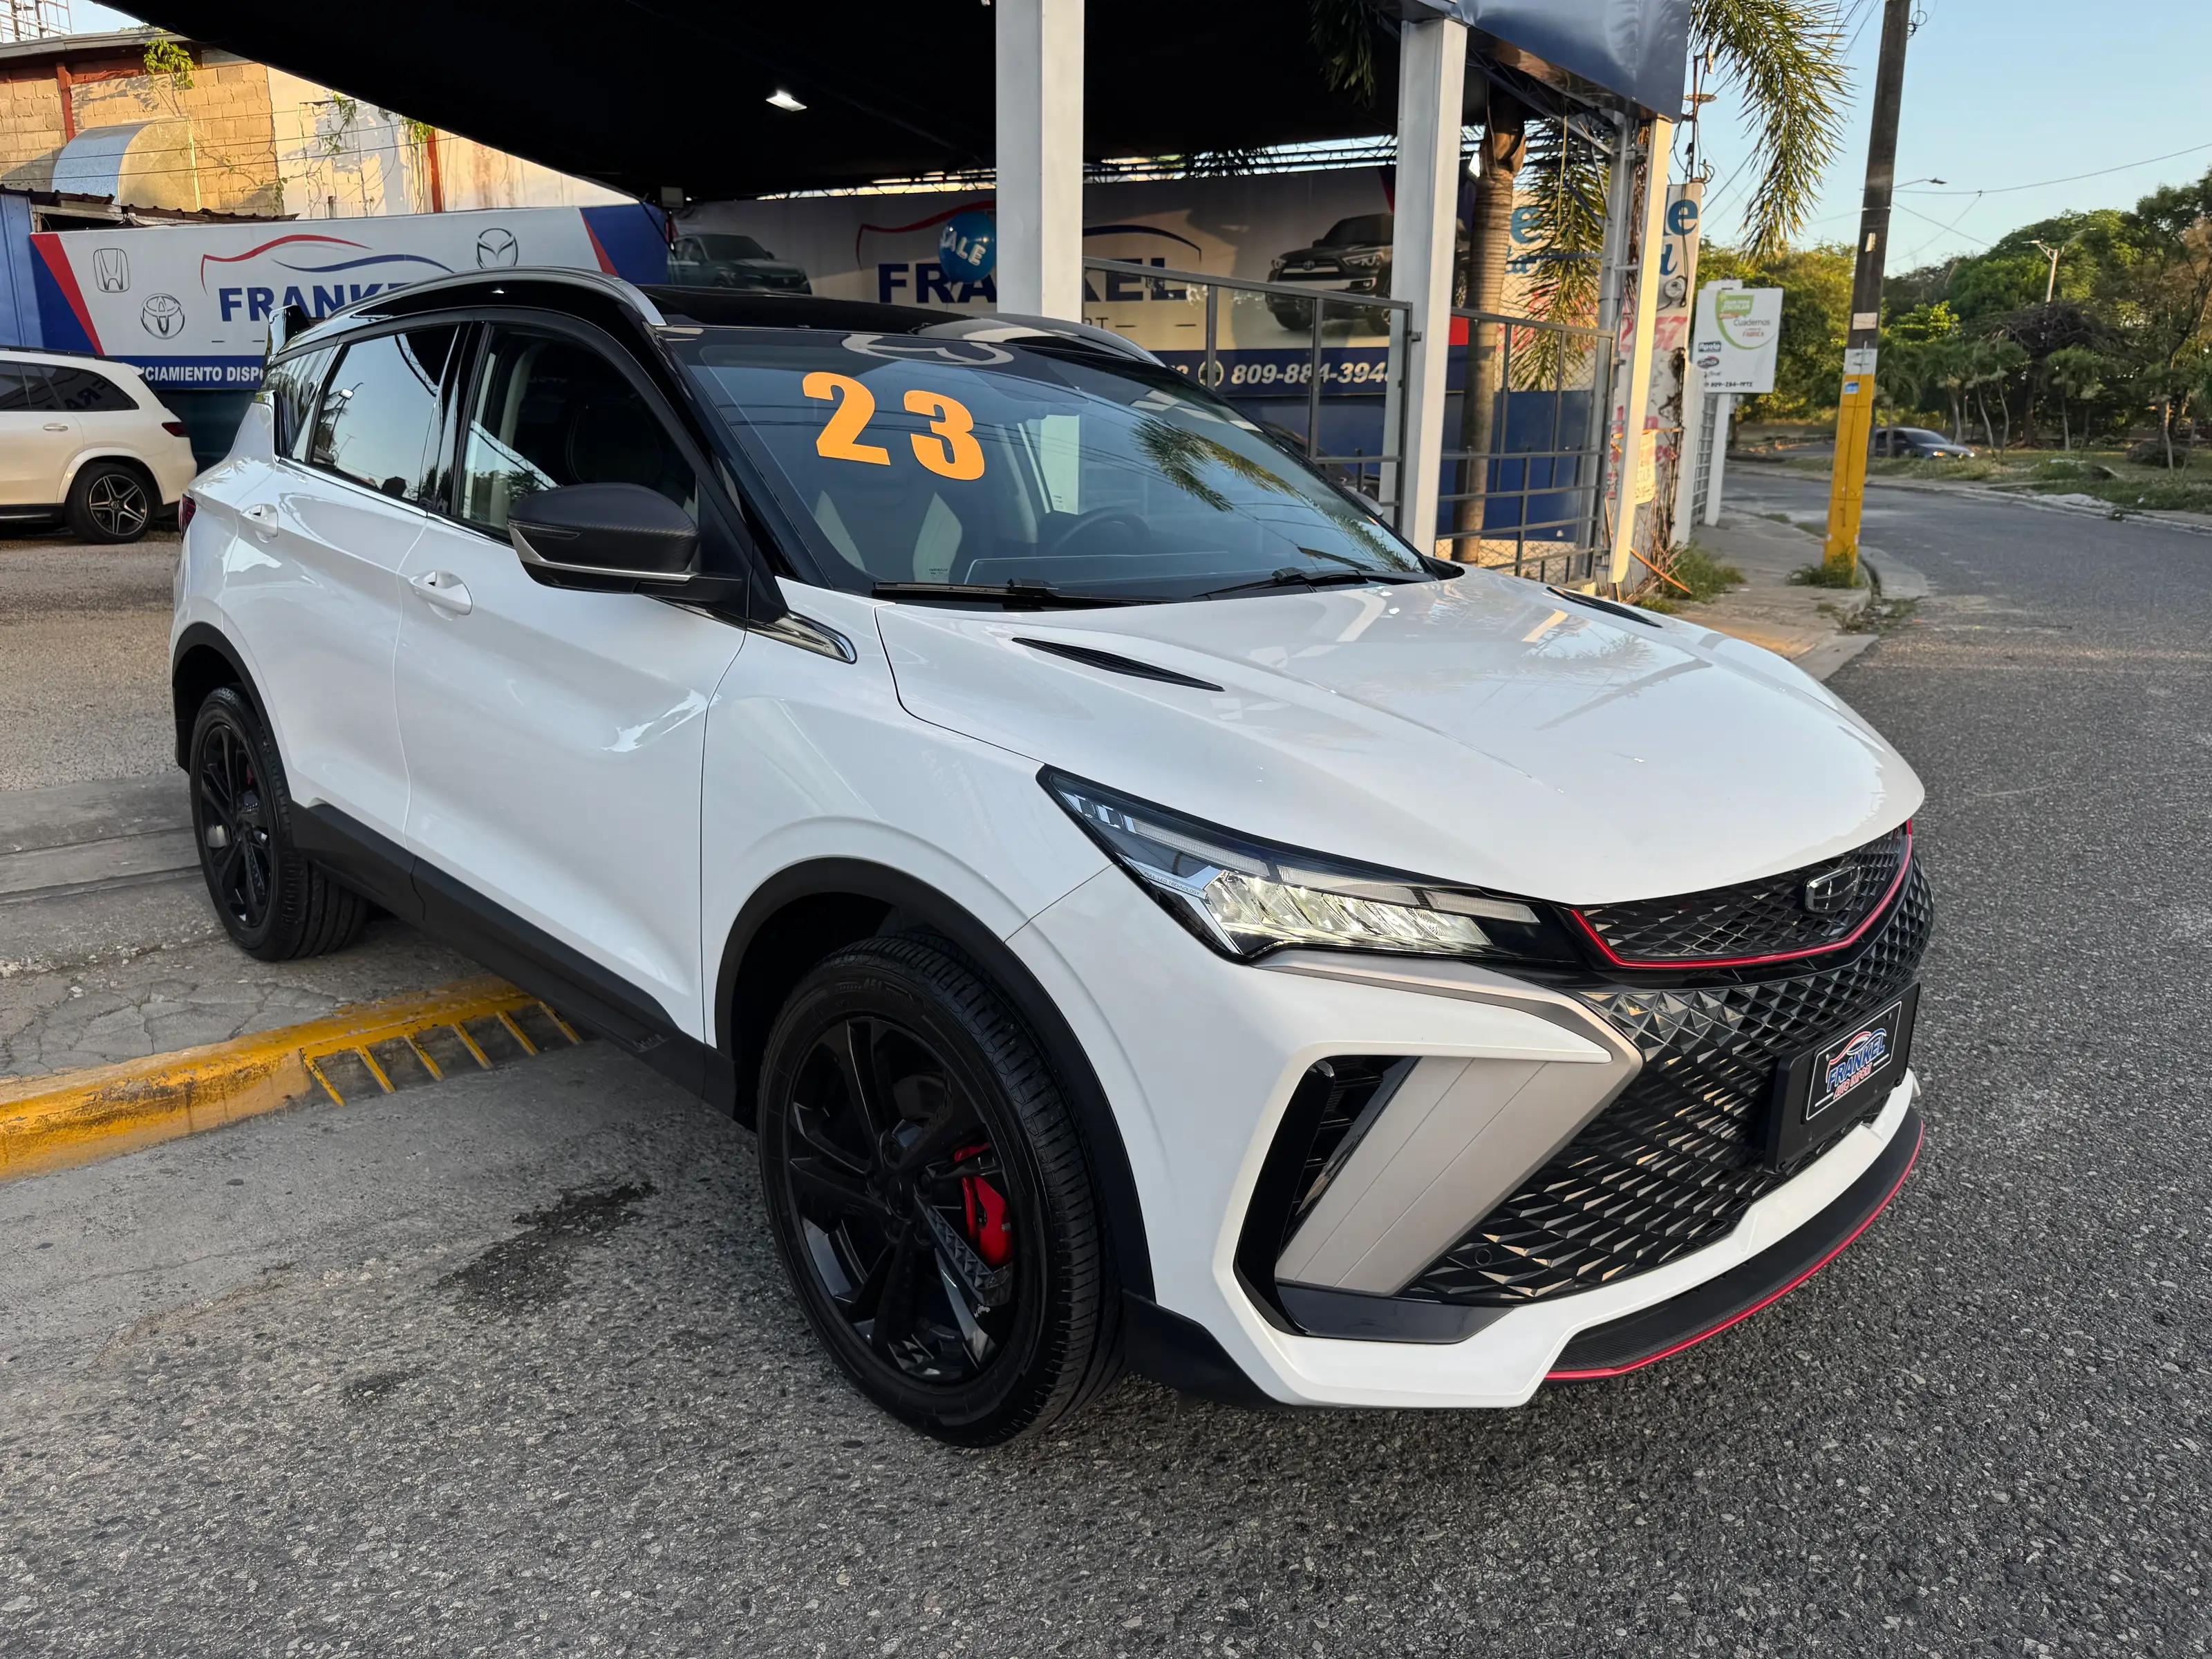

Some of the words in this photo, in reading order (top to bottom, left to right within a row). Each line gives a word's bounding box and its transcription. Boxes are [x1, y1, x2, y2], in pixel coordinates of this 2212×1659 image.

[1231, 362, 1388, 384] 809-884-394
[1168, 881, 1200, 895] TECHNOLOGY
[1826, 1035, 1885, 1093] FRANKEL
[1833, 1078, 1850, 1100] AUTO
[1850, 1062, 1873, 1087] IMPORT
